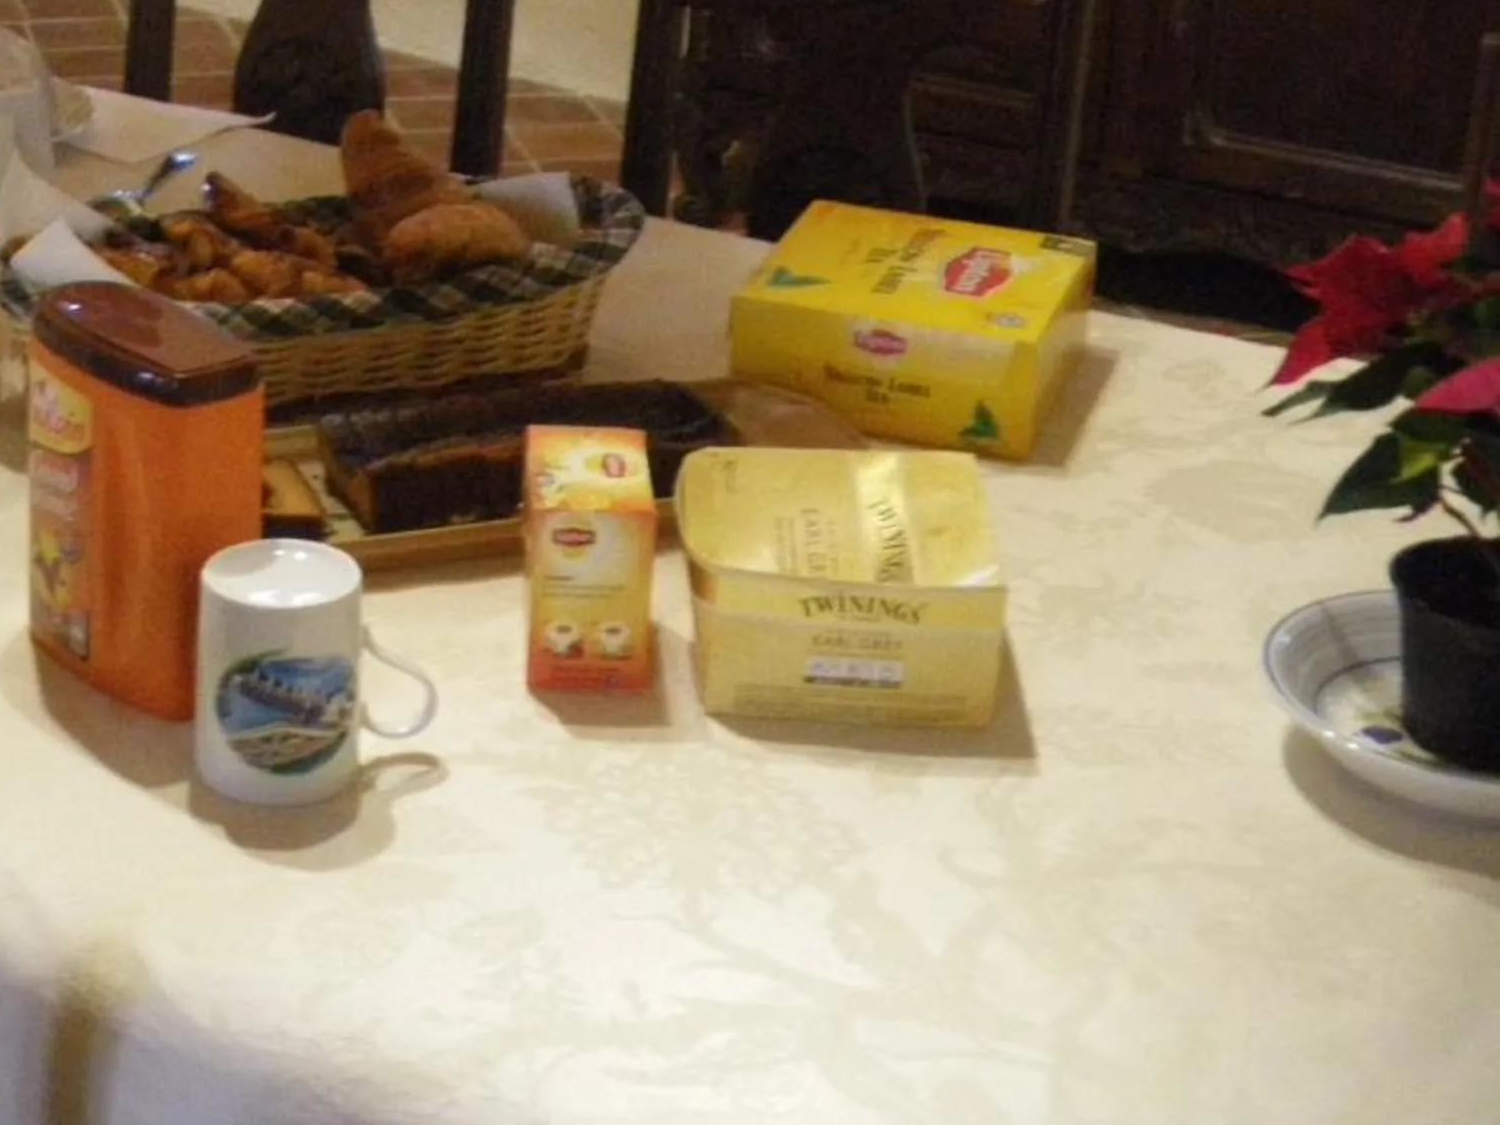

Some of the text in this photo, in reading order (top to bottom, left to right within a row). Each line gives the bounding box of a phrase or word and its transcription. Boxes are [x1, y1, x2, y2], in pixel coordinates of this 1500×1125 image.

[952, 249, 1005, 294] Lipton
[867, 498, 908, 584] TWINING
[797, 591, 930, 626] TWININGS
